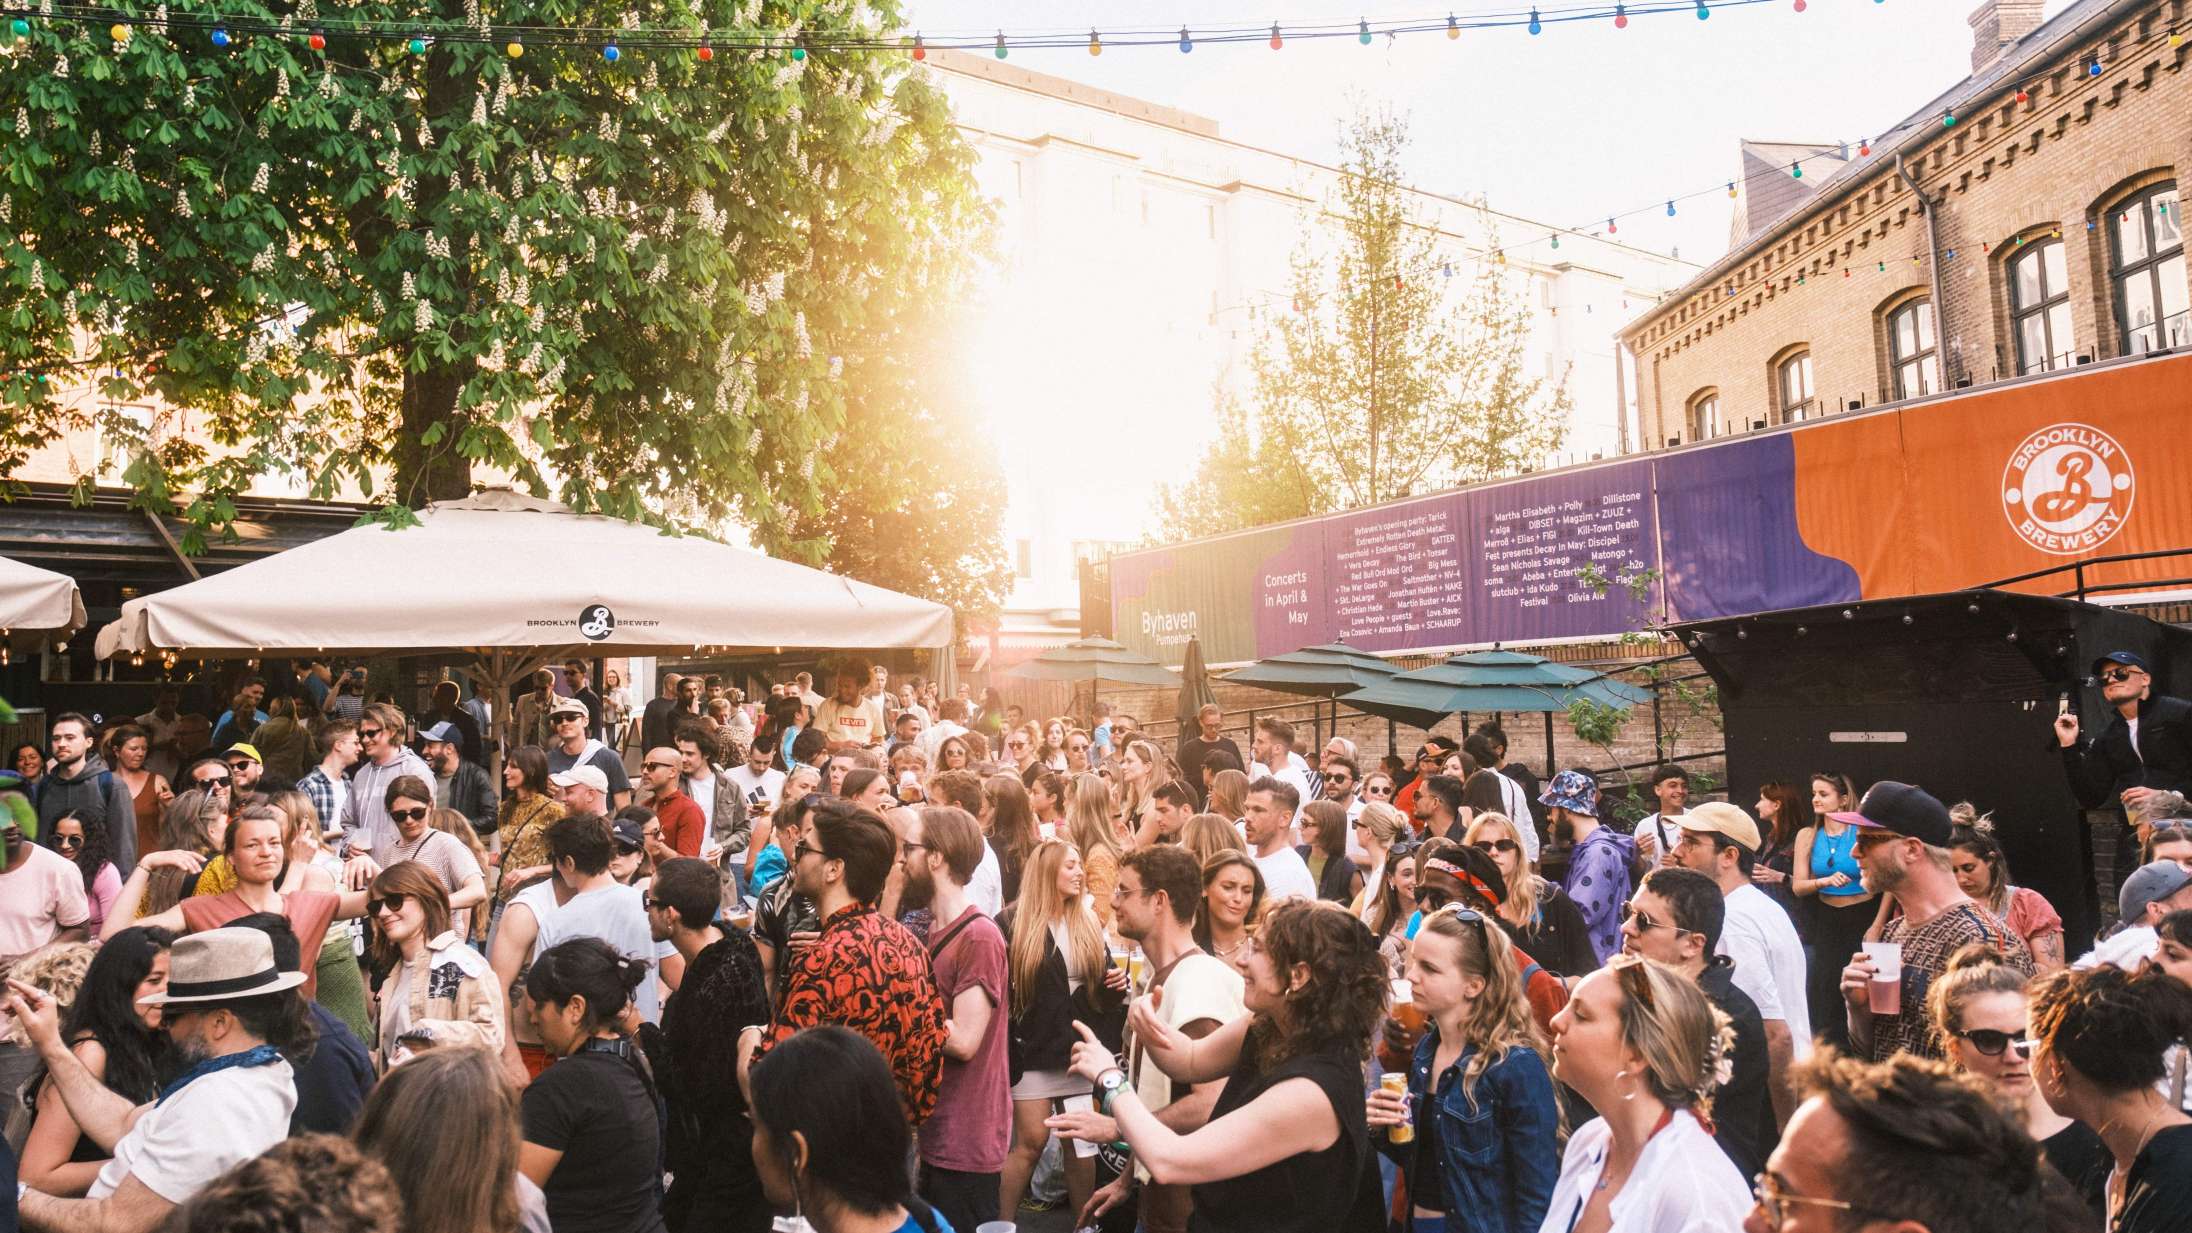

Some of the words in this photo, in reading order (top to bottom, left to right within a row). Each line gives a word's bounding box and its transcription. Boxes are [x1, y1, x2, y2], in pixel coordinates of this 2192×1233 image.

[2013, 428, 2116, 472] BROOKLYN
[1495, 510, 1520, 522] Martha
[1522, 504, 1556, 518] Elisabeth
[1564, 500, 1582, 511] Polly
[1602, 492, 1640, 505] Dillistone
[1602, 507, 1624, 518] ZUUZ
[1517, 534, 1534, 544] Elias
[1578, 524, 1612, 535] Kill-Town
[1615, 519, 1639, 530] Death
[2019, 507, 2120, 550] BREWERY
[1485, 552, 1500, 560] Fest
[1502, 548, 1533, 560] presents
[1535, 545, 1556, 554] Decay
[1558, 543, 1566, 551] In
[1568, 541, 1586, 550] May:
[1429, 561, 1439, 570] Big
[1492, 564, 1509, 572] Sean
[1511, 560, 1541, 570] Nicholas
[1544, 557, 1570, 566] Savage
[1592, 550, 1625, 560] Matongo
[1265, 571, 1307, 588] Concerts
[1484, 578, 1503, 586] soma
[1265, 594, 1274, 607] in
[1276, 590, 1298, 608] April
[1300, 589, 1307, 602] &
[1491, 587, 1518, 597] slutclub
[1527, 585, 1537, 594] Ida
[1540, 583, 1559, 592] Kudo
[1341, 606, 1366, 615] Christian
[1397, 599, 1418, 609] Martin
[1521, 596, 1548, 607] Festival
[1568, 592, 1590, 602] Olivia
[1142, 609, 1197, 638] Byhaven
[1288, 611, 1308, 625] May
[1351, 617, 1365, 626] Love
[1391, 612, 1412, 622] guests
